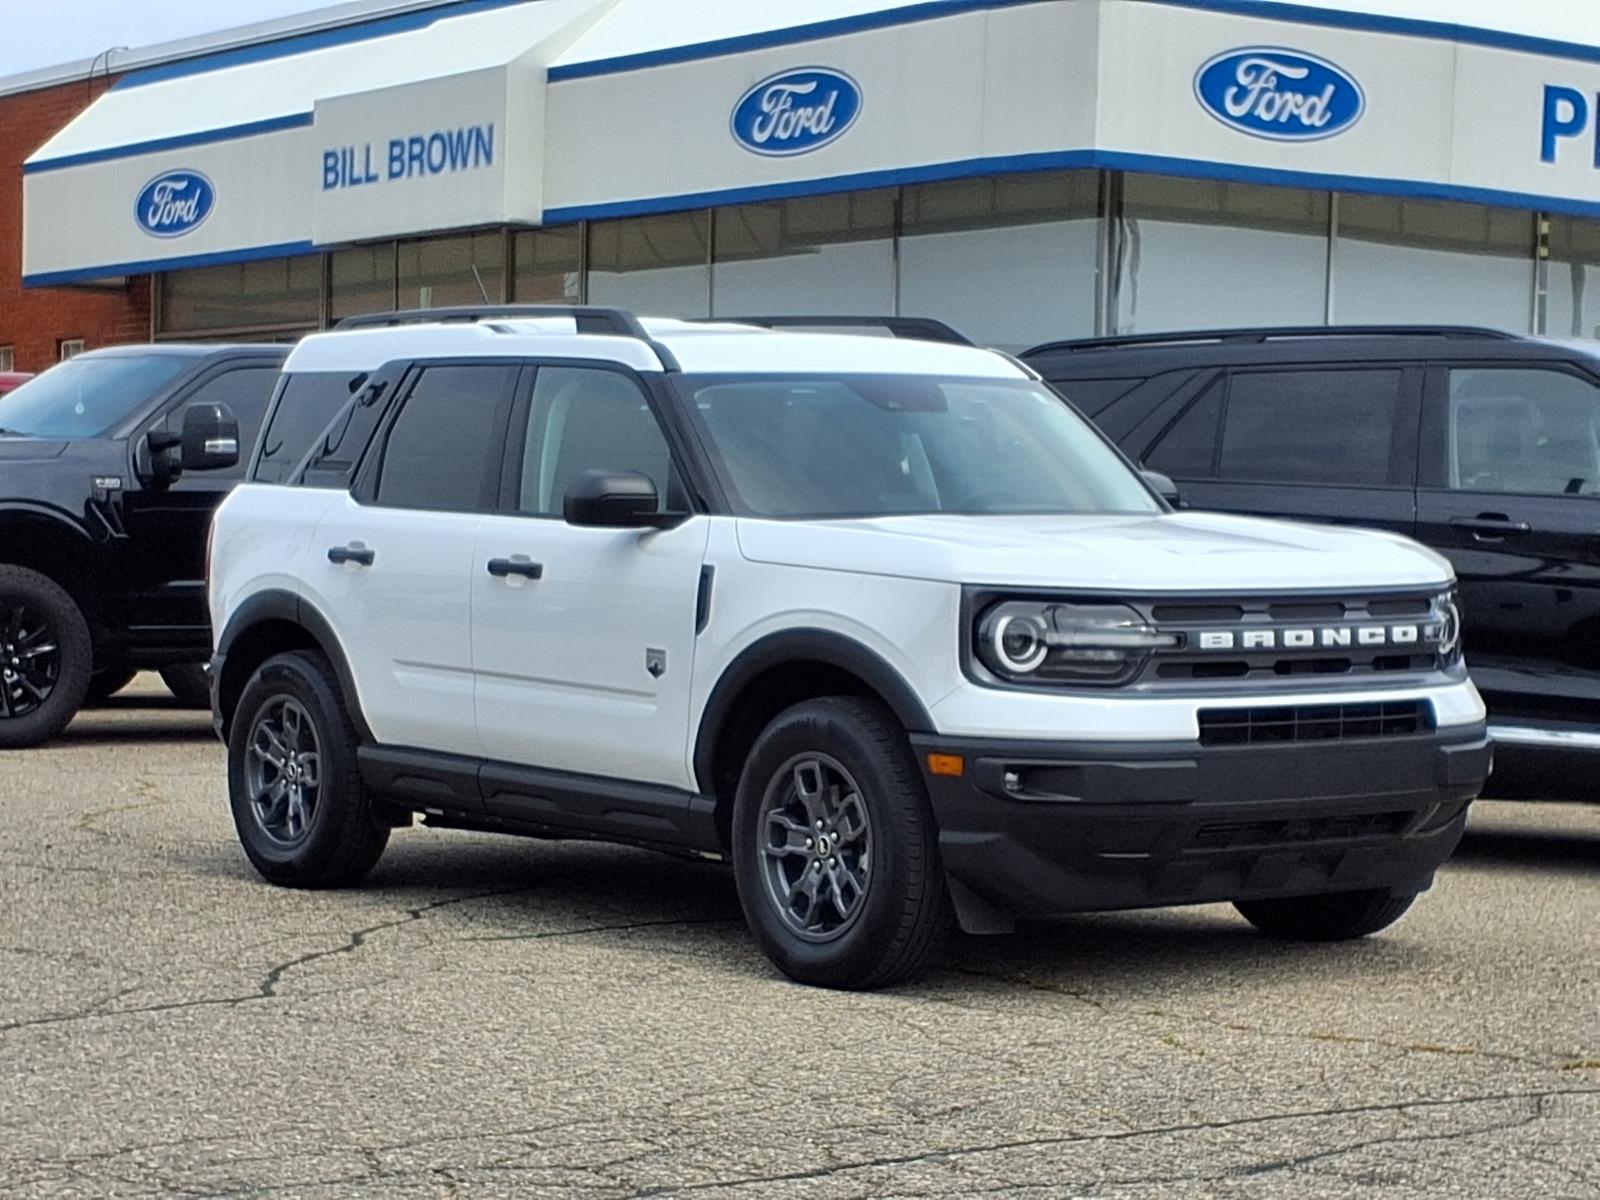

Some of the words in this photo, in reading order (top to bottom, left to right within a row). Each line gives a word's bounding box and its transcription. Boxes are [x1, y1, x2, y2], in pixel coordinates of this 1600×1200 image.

[752, 81, 838, 144] Ford
[1224, 58, 1335, 127] Ford
[323, 147, 378, 189] BILL
[388, 124, 494, 178] BROWN
[1540, 84, 1600, 169] P
[147, 178, 199, 224] Ford
[1199, 625, 1418, 649] BRONCO
